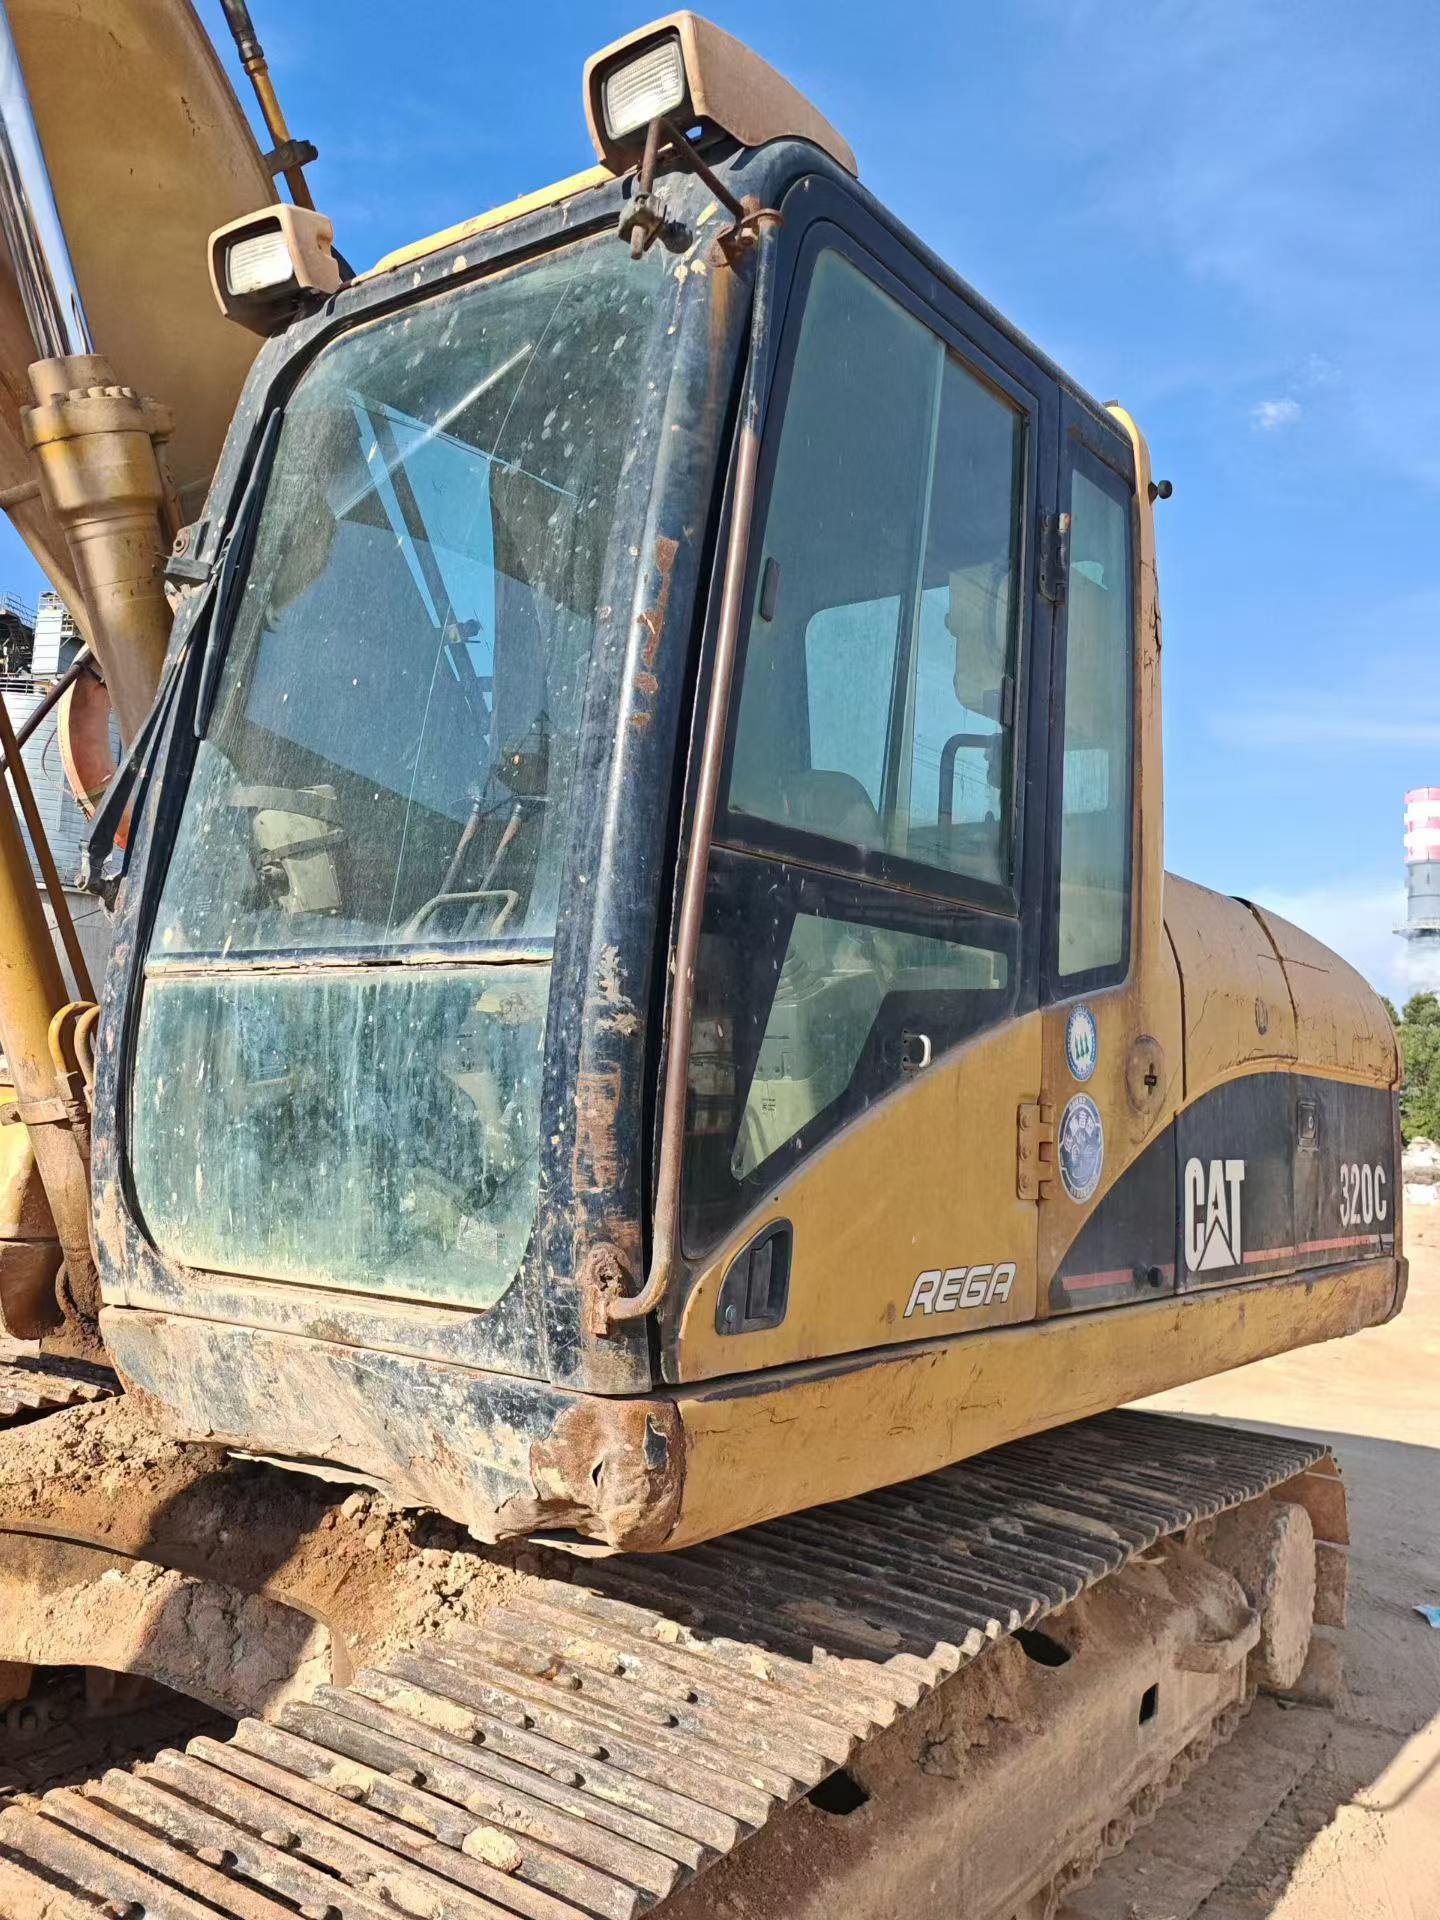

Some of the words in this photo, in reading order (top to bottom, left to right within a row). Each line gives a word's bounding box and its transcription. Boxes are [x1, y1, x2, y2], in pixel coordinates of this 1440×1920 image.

[1184, 1157, 1246, 1272] CAT
[1340, 1163, 1388, 1227] 320C
[903, 1261, 1017, 1318] REGA
